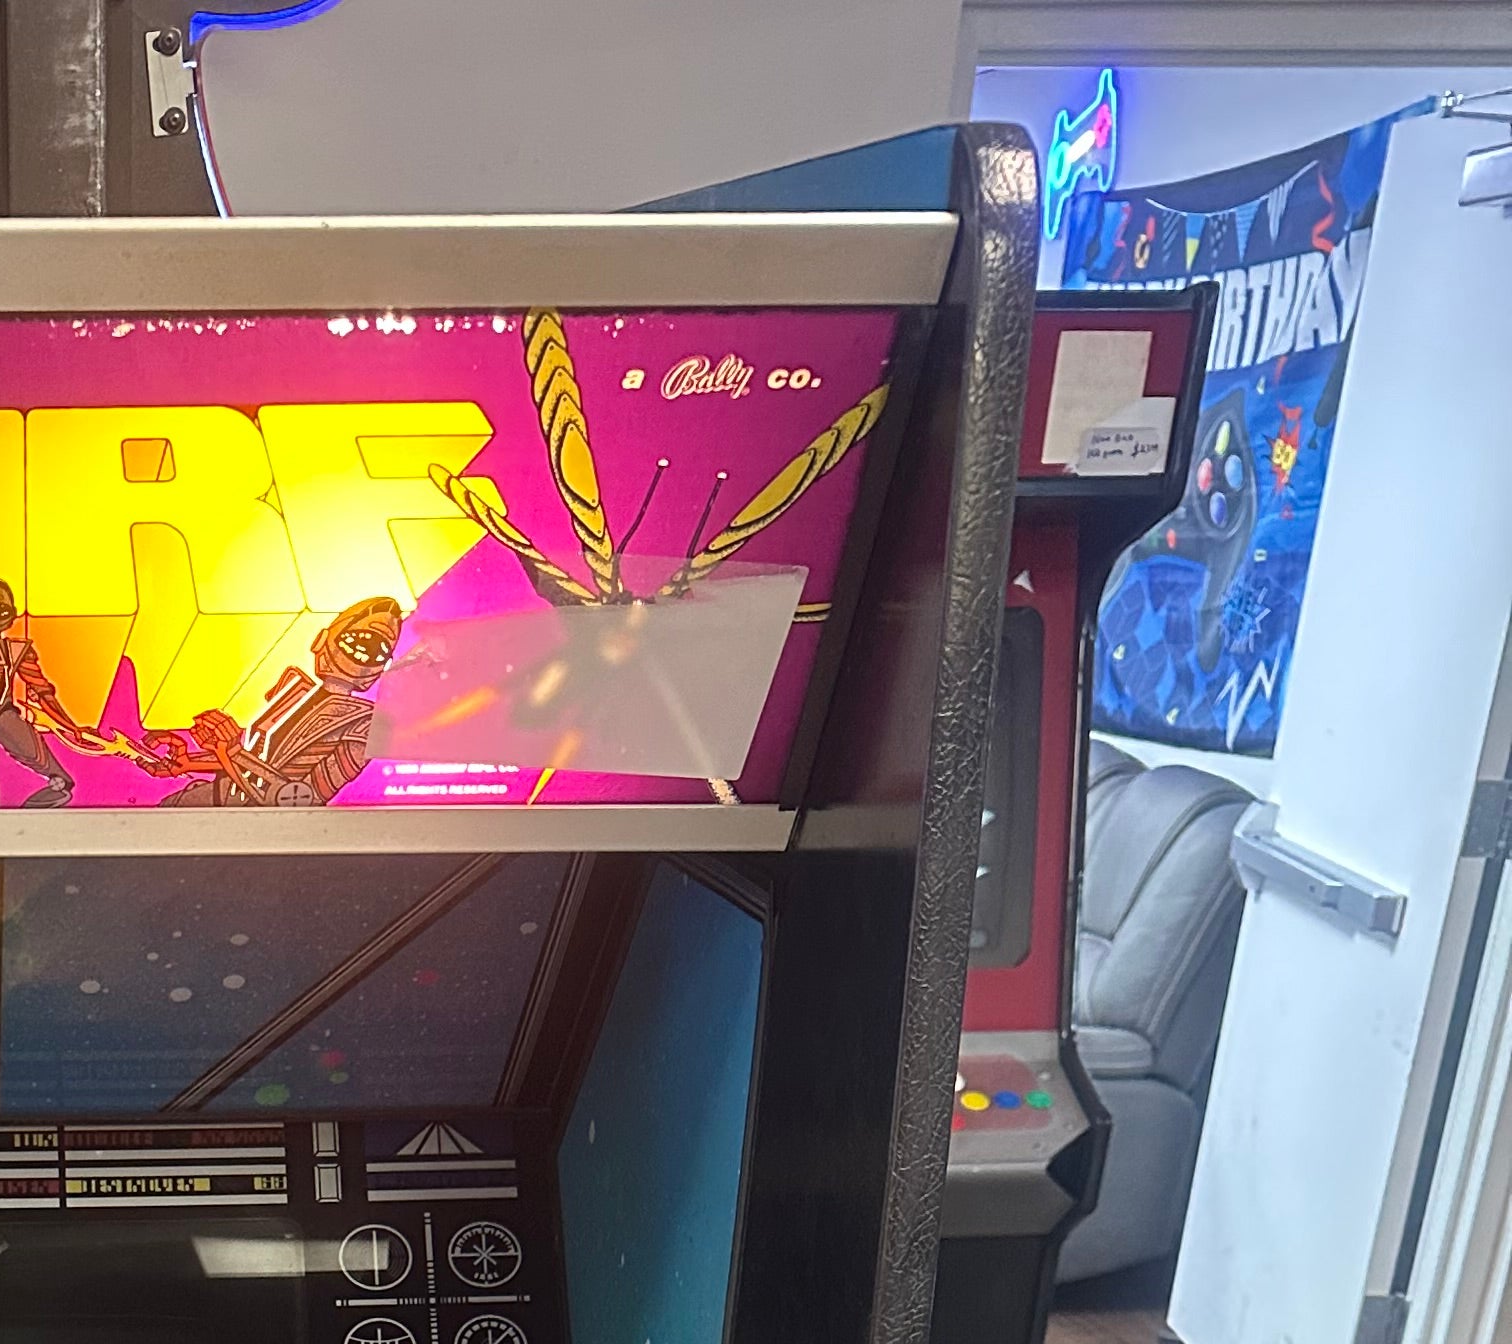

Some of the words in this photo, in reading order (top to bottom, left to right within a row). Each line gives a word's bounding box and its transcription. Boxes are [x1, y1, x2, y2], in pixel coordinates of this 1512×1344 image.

[621, 368, 646, 391] a
[660, 353, 755, 400] Bally
[767, 367, 823, 391] co.
